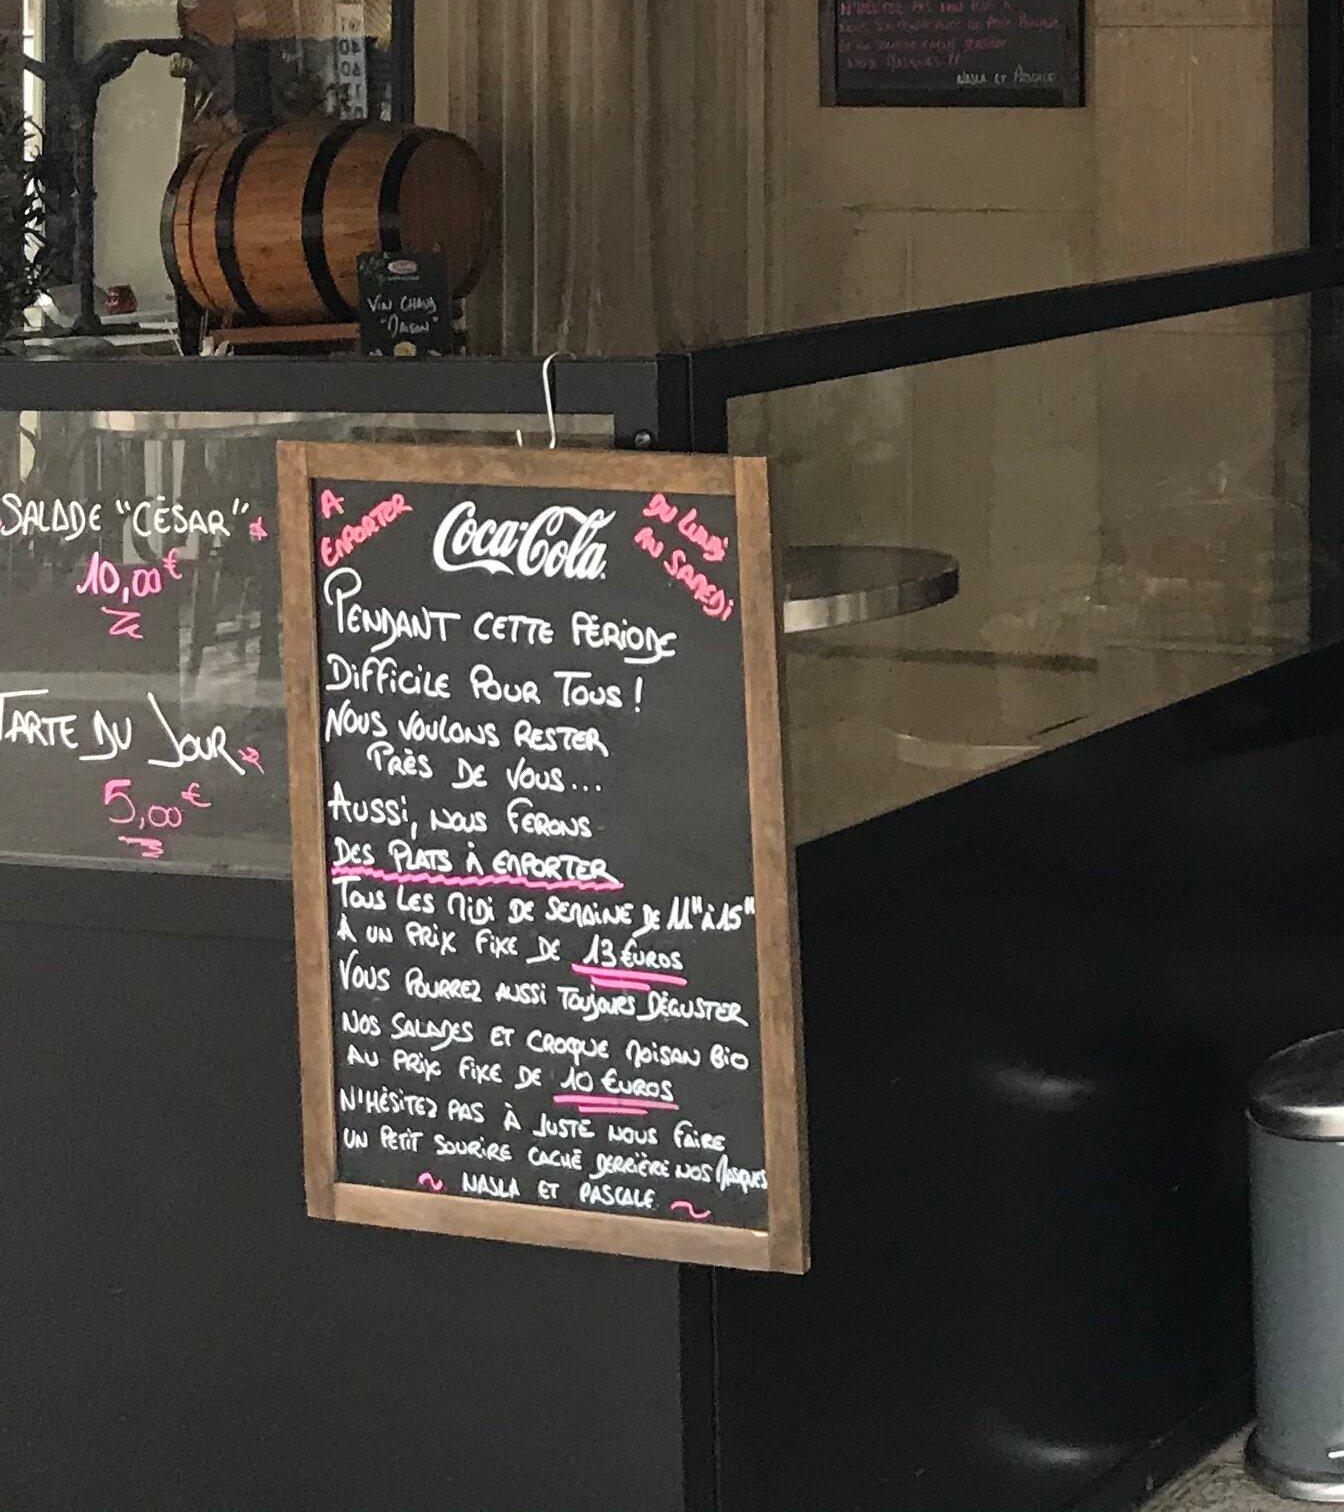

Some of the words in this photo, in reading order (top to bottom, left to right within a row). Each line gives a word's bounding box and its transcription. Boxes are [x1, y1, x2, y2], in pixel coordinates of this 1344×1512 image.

[1, 493, 102, 542] SALADE
[642, 493, 679, 524] DU
[323, 567, 461, 653] PENDANT
[473, 611, 555, 646] CETTE
[470, 663, 541, 706] POUR
[554, 670, 623, 708] TOUS
[79, 709, 133, 762] DU
[147, 691, 247, 776] JOUR
[325, 701, 388, 745] NOUS
[399, 709, 500, 748] VOULONS
[513, 720, 609, 757] RESTER
[451, 759, 488, 789] DE
[430, 807, 487, 834] NOUS
[507, 797, 593, 838] FERONS
[333, 836, 375, 866] DES
[388, 838, 454, 875] PLATS
[331, 875, 387, 913] TOUS
[396, 885, 435, 915] LES
[508, 900, 535, 923] DE
[630, 904, 662, 939] DE
[366, 923, 394, 946] UN
[526, 938, 561, 964] DE
[583, 937, 617, 968] 13
[338, 949, 390, 993] VOUS
[404, 966, 482, 1005] POURREZ
[557, 986, 637, 1022] TOUJOURS
[342, 1010, 382, 1037] NOS
[390, 1011, 474, 1052] SALADES
[489, 1023, 515, 1048] ET
[526, 1028, 610, 1066] CROQUE
[346, 1044, 380, 1068] AU
[513, 1064, 543, 1090] DE
[560, 1066, 594, 1091] 10
[446, 1100, 486, 1124] PAS
[533, 1112, 596, 1140] JUSTE
[607, 1122, 659, 1147] NOUS
[342, 1127, 368, 1150] UN
[674, 1158, 713, 1185] NOS
[536, 1178, 559, 1201] ET
[578, 1178, 657, 1211] PASCALE
